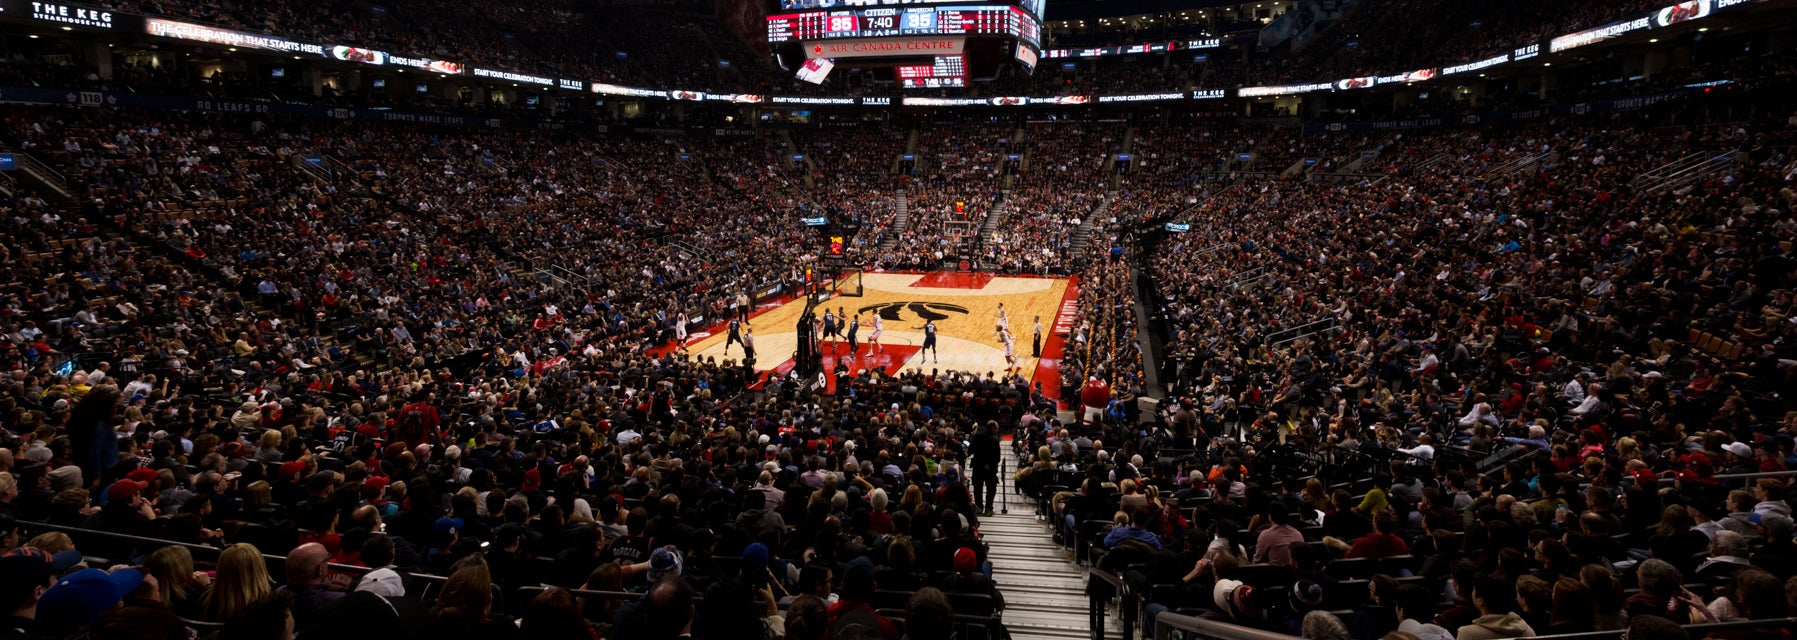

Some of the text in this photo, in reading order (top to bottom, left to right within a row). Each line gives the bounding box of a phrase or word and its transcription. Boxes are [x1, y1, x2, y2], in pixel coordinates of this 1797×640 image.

[32, 2, 112, 22] THE KEG
[864, 8, 896, 17] CITIZEN
[34, 13, 90, 25] STEAKHOUSE
[831, 17, 852, 32] 35
[867, 17, 893, 29] 7:40
[908, 13, 931, 28] 35
[1595, 27, 1609, 38] THAT
[1608, 22, 1631, 35] STARTS
[1631, 16, 1650, 30] HERE
[151, 21, 323, 55] THE CELEBRATION THAT STARTS HERE
[829, 41, 954, 52] AIR CANADA CENTRE
[1515, 44, 1539, 56] THE KEG
[390, 56, 426, 67] ENDS HERE
[474, 68, 489, 77] START
[489, 70, 503, 78] YOUR
[503, 72, 534, 83] CELEBRATION
[82, 94, 101, 104] 118
[197, 100, 268, 113] GO LEAFS GO
[384, 112, 463, 124] TORONTO MAPLE LEAFS
[1372, 120, 1397, 128] TORONTO
